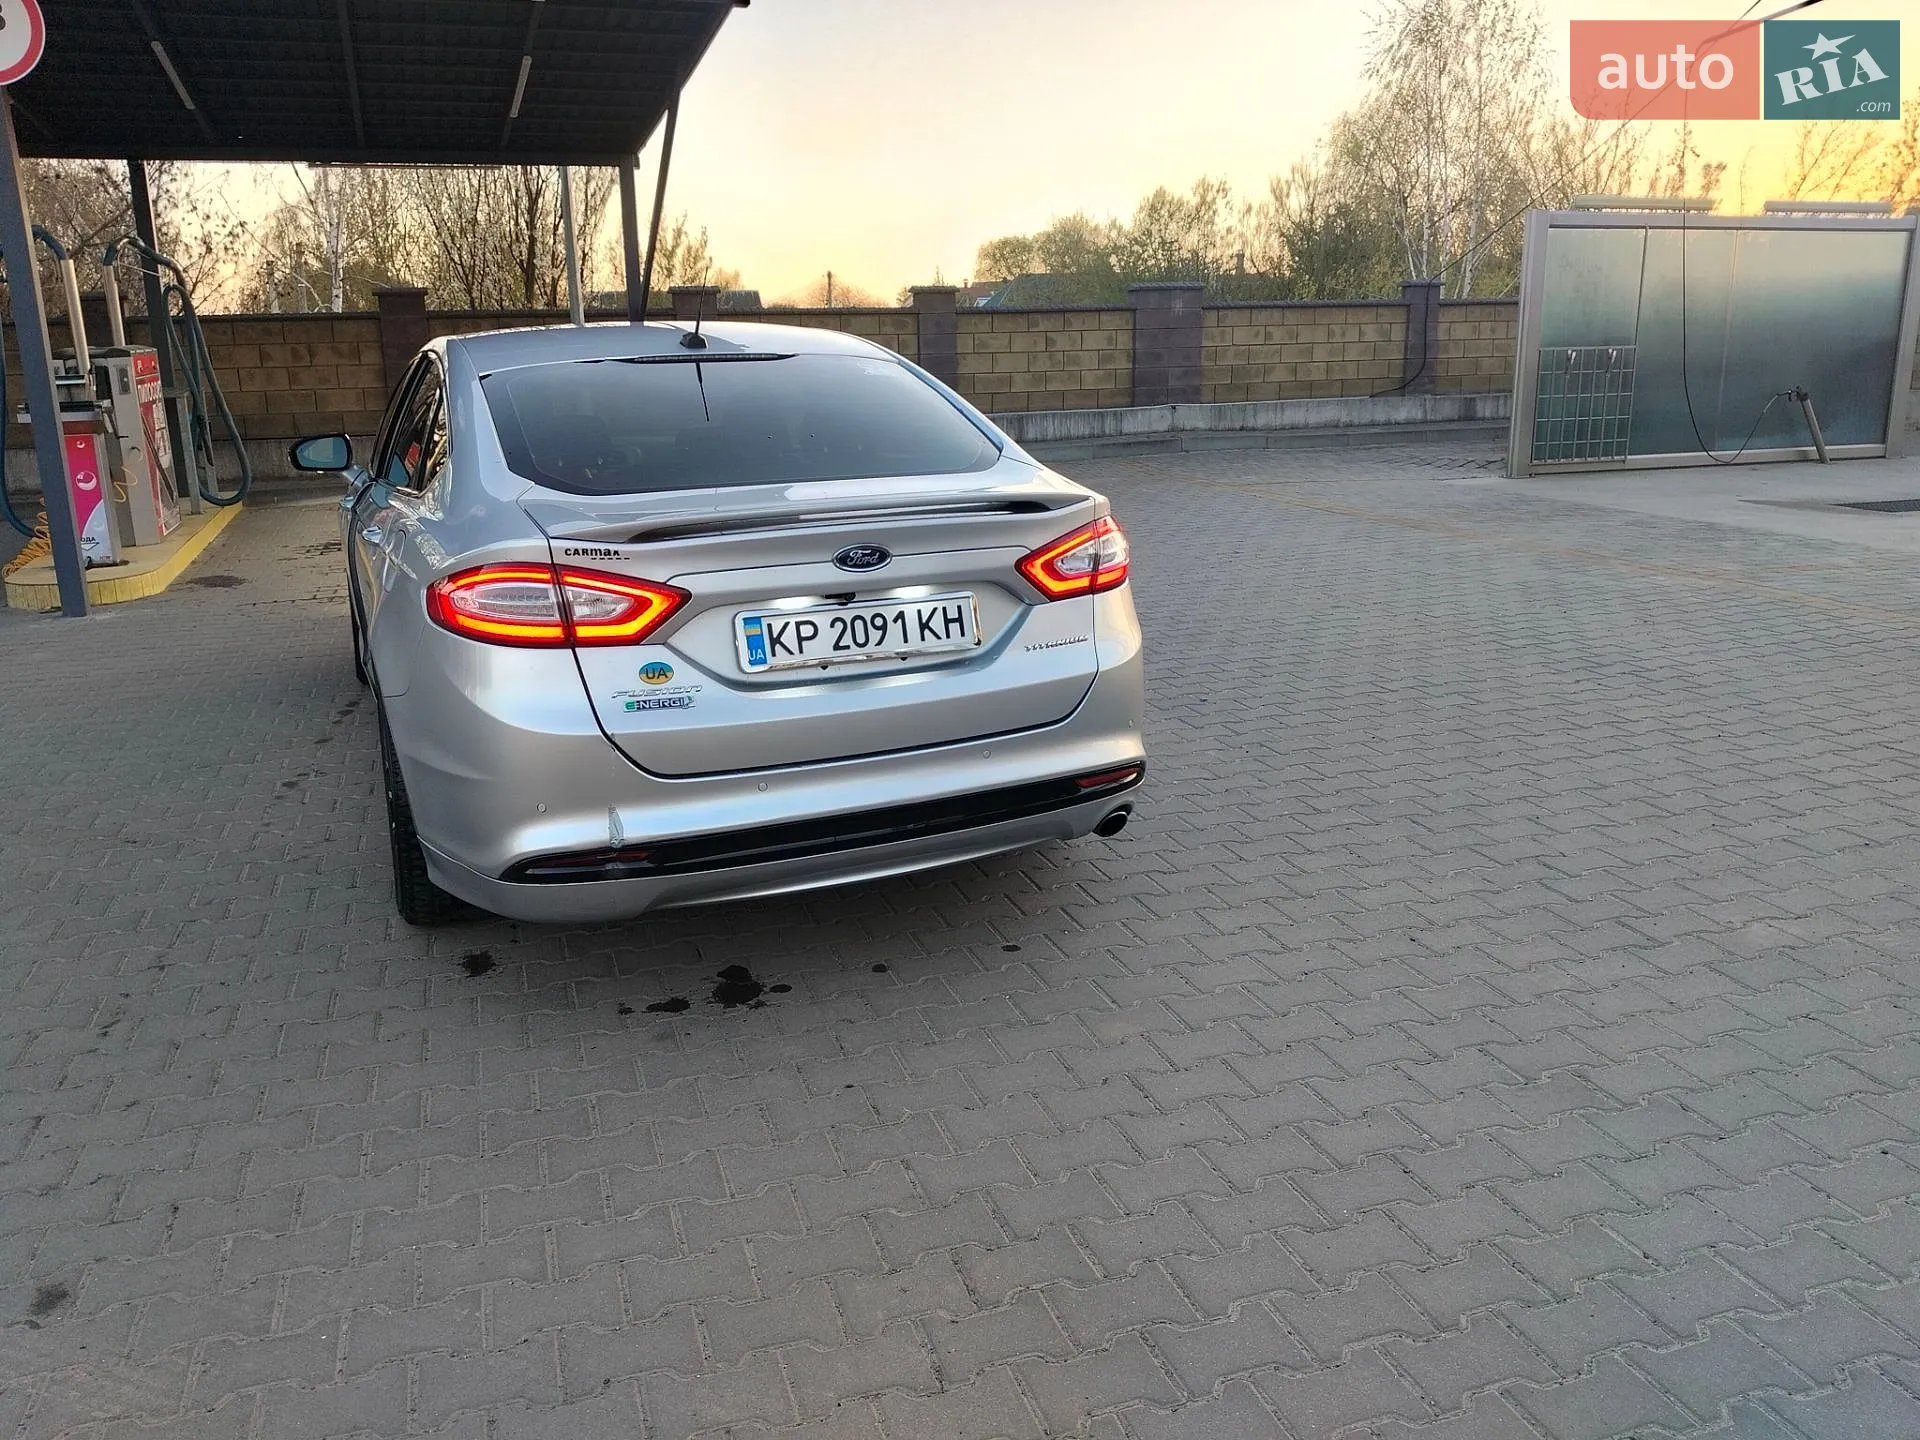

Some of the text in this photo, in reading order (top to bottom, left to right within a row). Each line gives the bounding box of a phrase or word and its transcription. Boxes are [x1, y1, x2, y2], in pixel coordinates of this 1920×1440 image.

[847, 549, 880, 565] Ford
[830, 610, 909, 652] 2091
[748, 648, 765, 661] UA
[645, 667, 668, 680] UA
